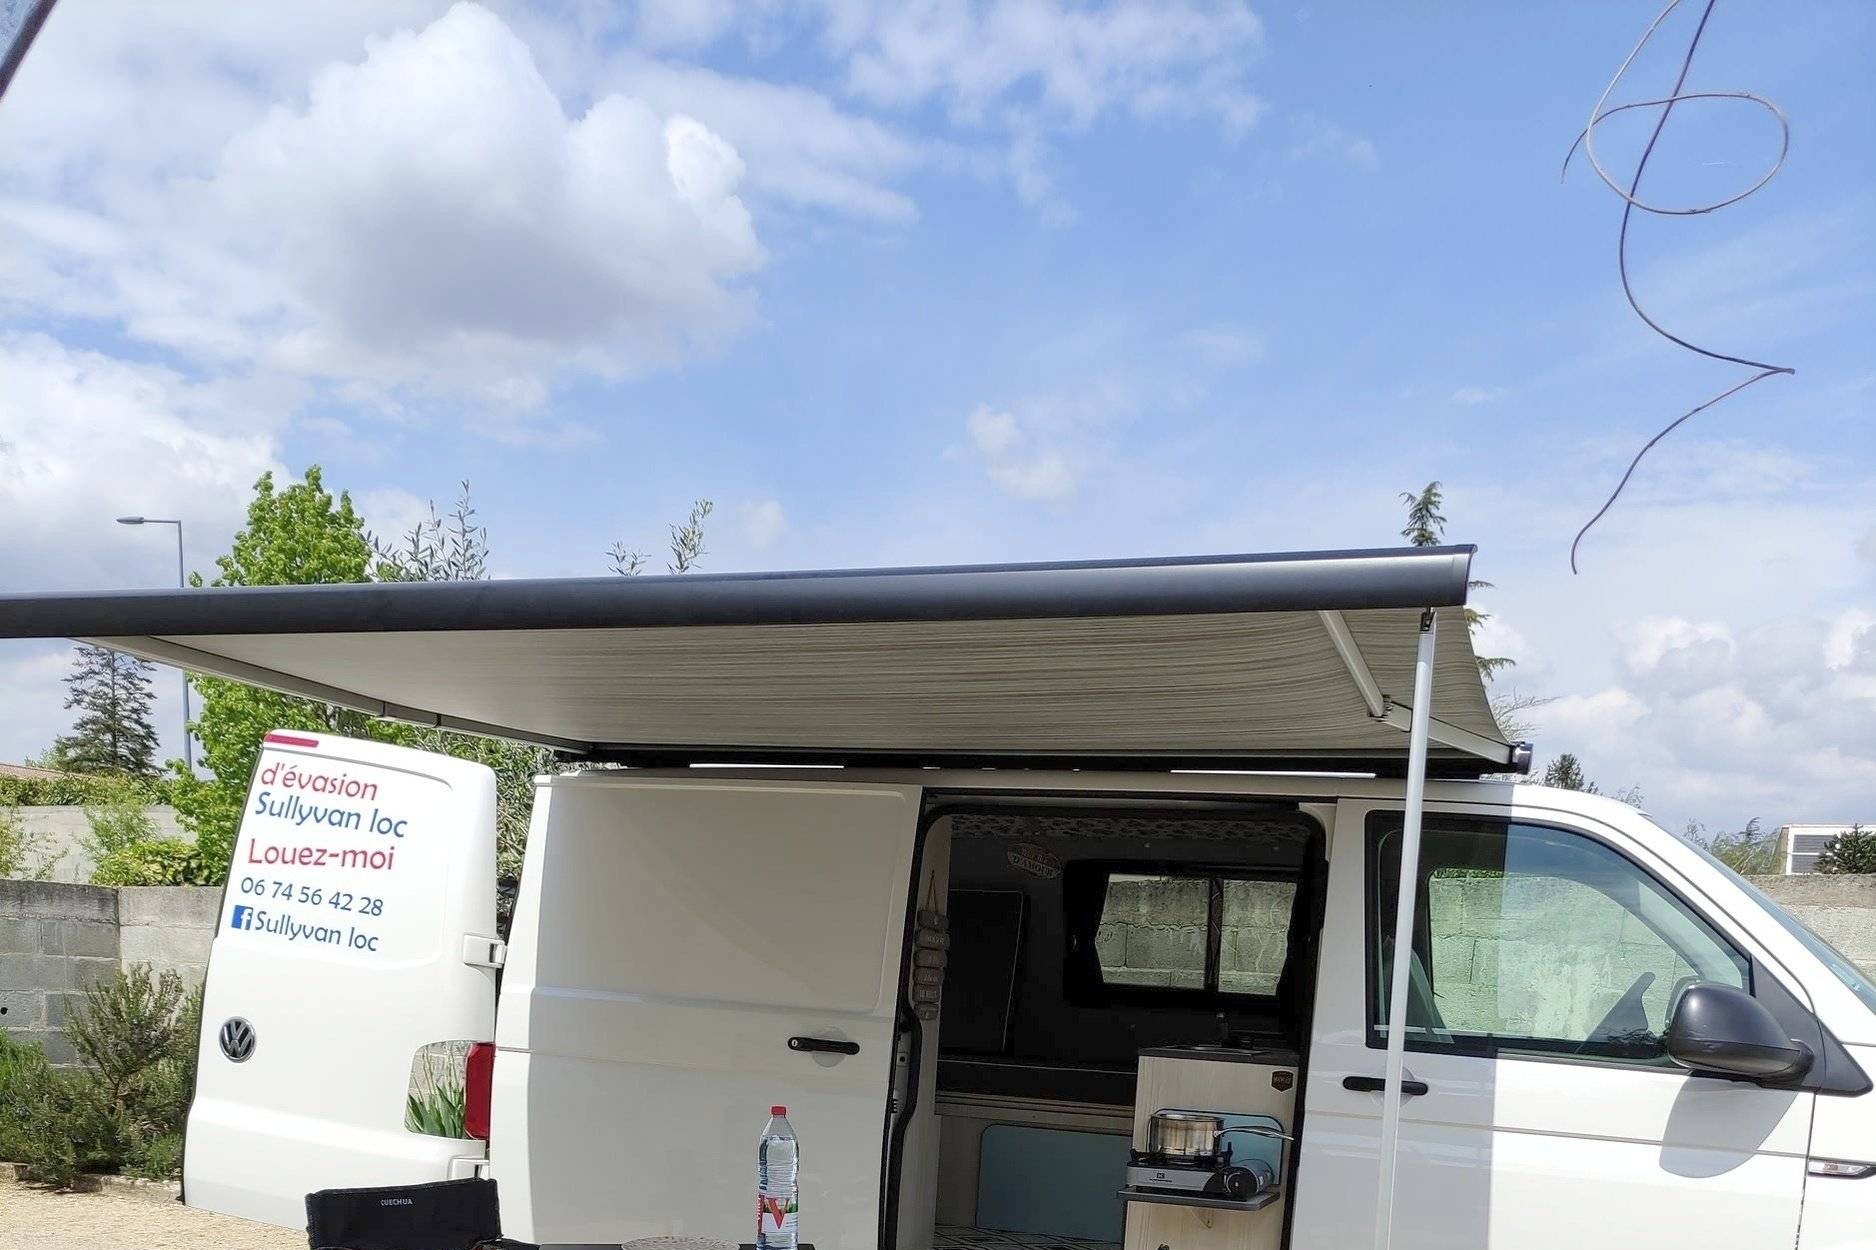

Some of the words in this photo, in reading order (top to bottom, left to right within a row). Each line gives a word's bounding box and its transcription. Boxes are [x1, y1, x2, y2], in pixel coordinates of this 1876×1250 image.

[261, 762, 377, 800] d'évasion
[255, 791, 361, 830] Sullyvan
[369, 808, 408, 838] loc
[248, 839, 395, 870] Louez-moi
[240, 877, 265, 896] 06
[271, 881, 293, 901] 74
[298, 886, 322, 906] 56
[328, 891, 353, 912] 42
[358, 896, 383, 917] 28
[255, 911, 341, 944] Sullyvan
[348, 926, 379, 952] loc
